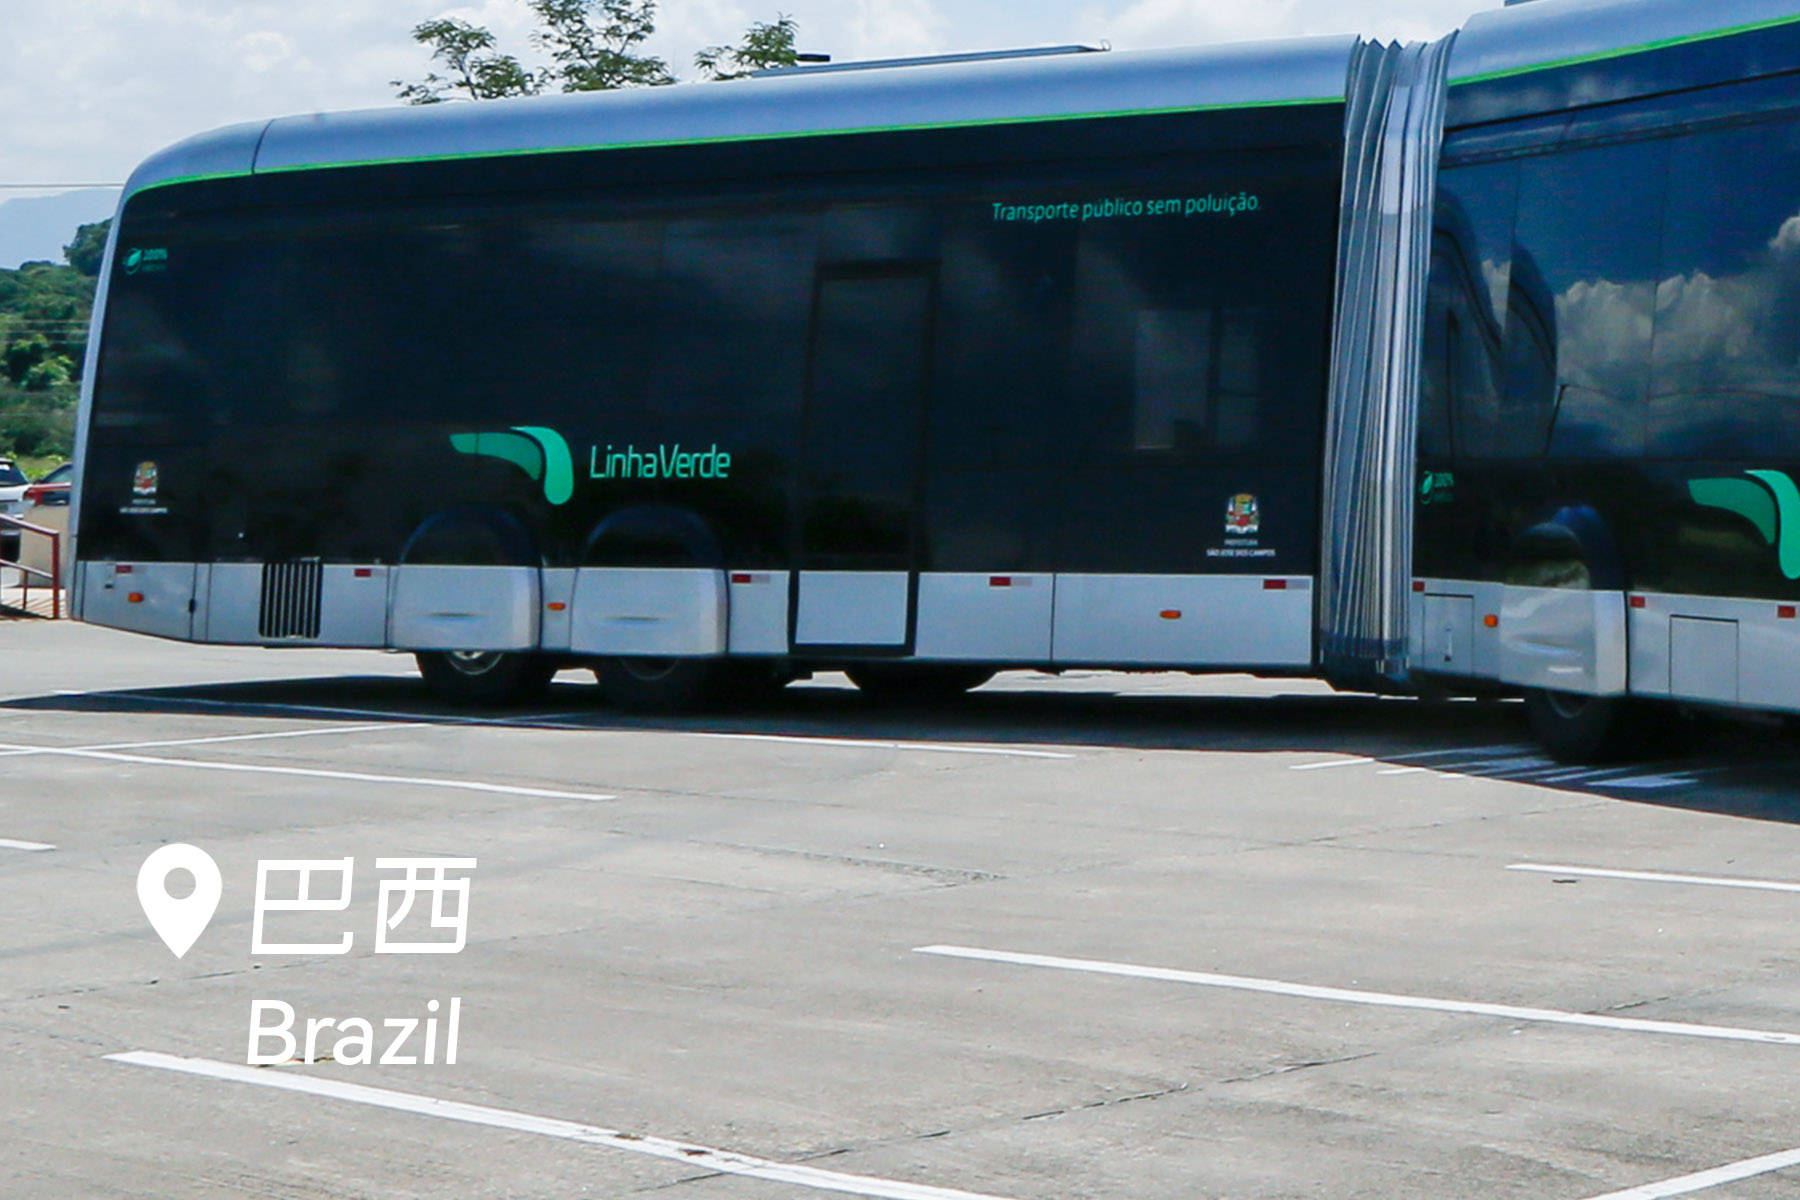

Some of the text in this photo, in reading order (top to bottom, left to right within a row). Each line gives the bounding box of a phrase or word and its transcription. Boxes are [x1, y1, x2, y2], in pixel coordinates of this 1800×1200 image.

[991, 202, 1080, 223] Transporte
[1081, 197, 1143, 222] público
[1146, 198, 1182, 216] sem
[589, 443, 731, 478] LinhaVerde
